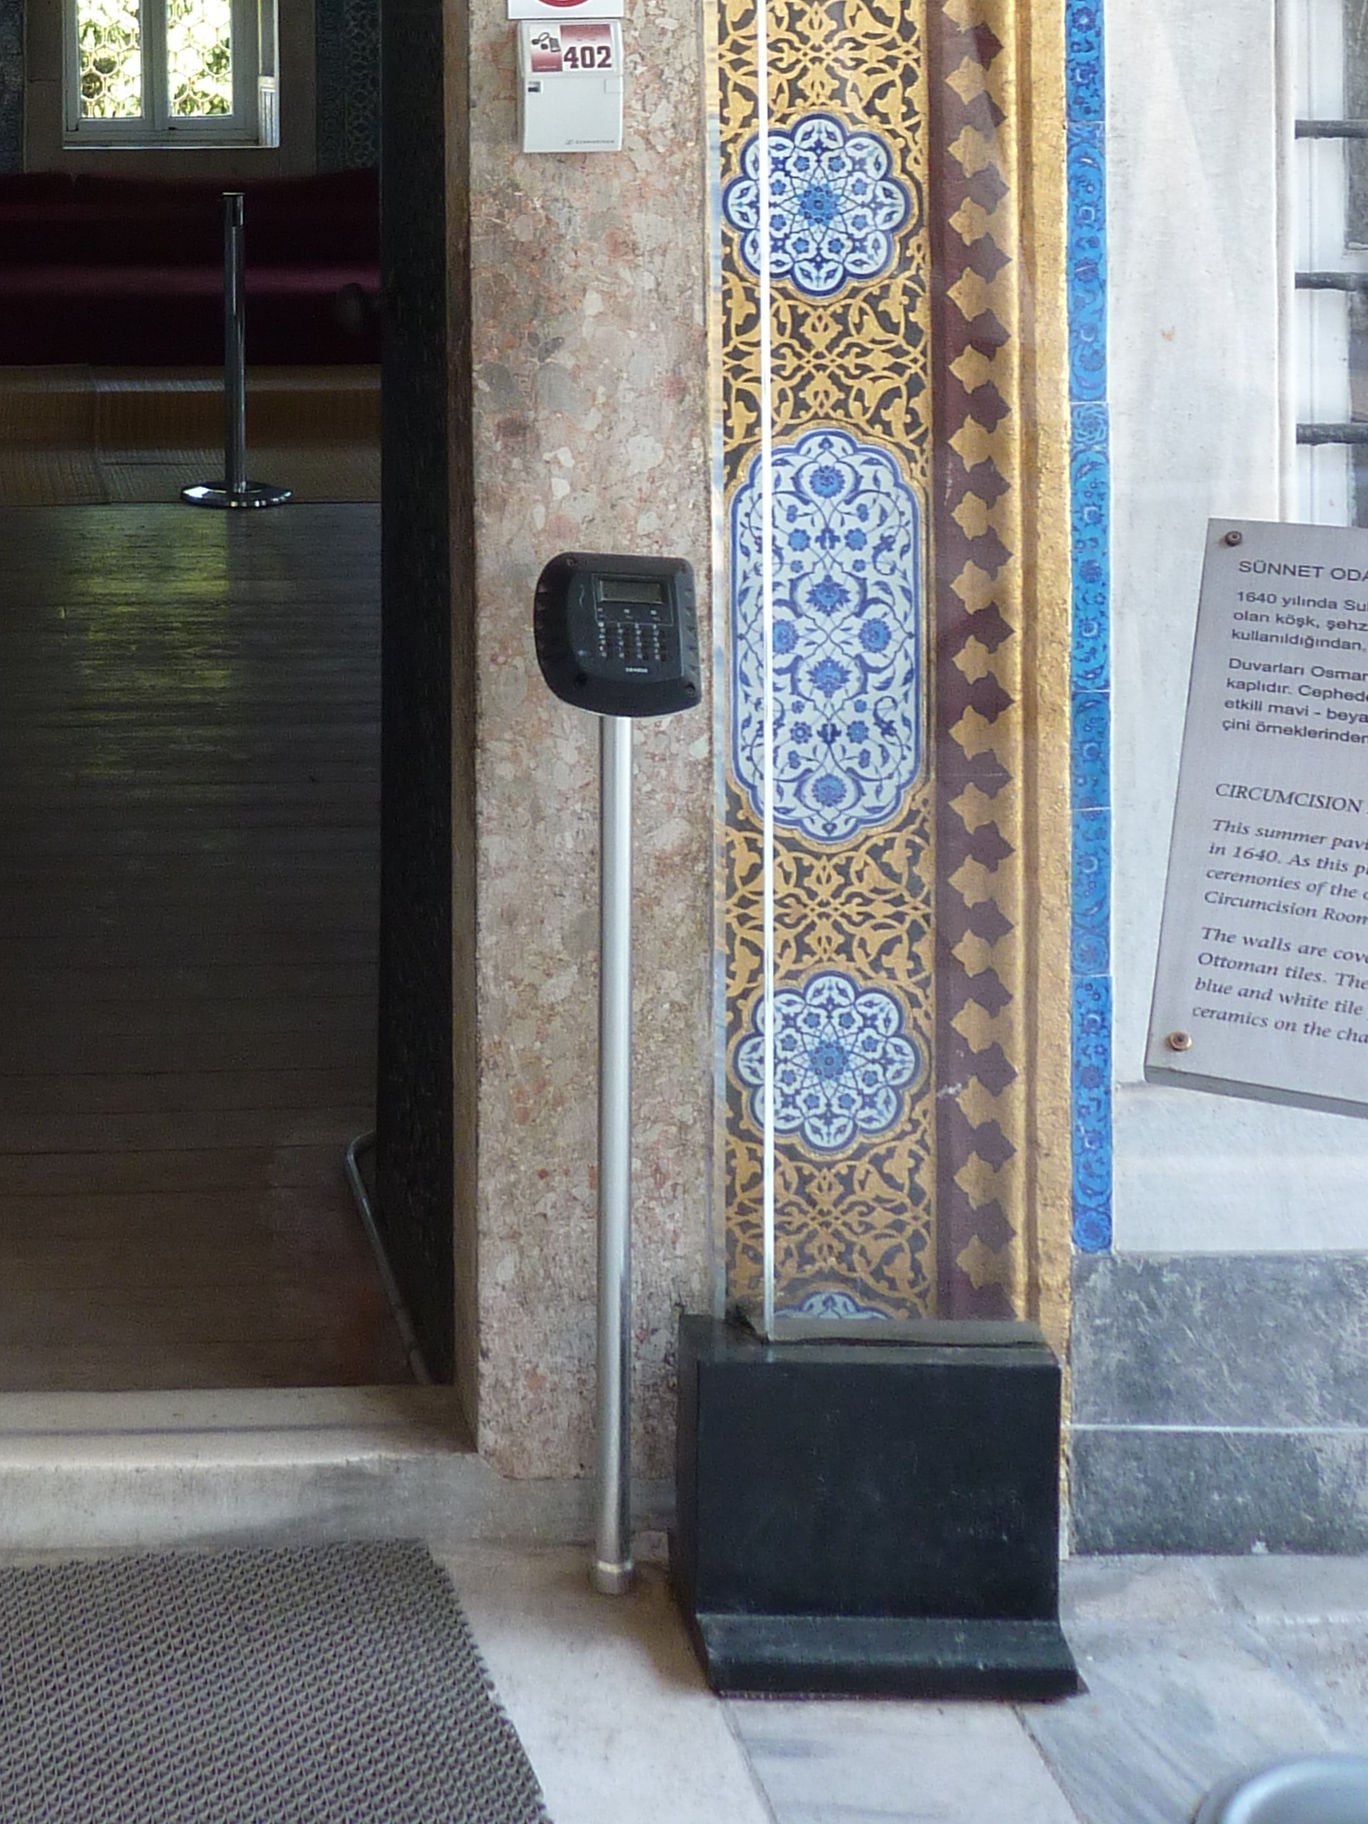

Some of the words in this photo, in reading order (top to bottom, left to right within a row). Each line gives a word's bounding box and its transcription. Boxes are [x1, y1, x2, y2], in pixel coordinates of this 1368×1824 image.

[563, 45, 612, 69] 402
[1238, 559, 1324, 578] SÜNNET
[1237, 591, 1276, 604] 1640
[1282, 595, 1338, 610] yılında
[1233, 611, 1270, 622] olan
[1276, 613, 1320, 629] köşk,
[1228, 657, 1305, 676] Duvarları
[1226, 678, 1293, 695] kaplıdır.
[1267, 704, 1309, 716] mavi
[1222, 718, 1251, 731] çini
[1215, 783, 1363, 813] CIRCUMCISION
[1212, 819, 1251, 835] This
[1255, 827, 1328, 844] summer
[1209, 843, 1226, 855] in
[1286, 854, 1311, 867] As
[1316, 857, 1349, 872] this
[1206, 869, 1301, 890] ceremonies
[1306, 881, 1328, 897] of
[1329, 884, 1358, 898] the
[1204, 891, 1317, 918] Circumcision
[1201, 926, 1237, 944] The
[1242, 935, 1292, 952] walls
[1297, 944, 1328, 957] are
[1197, 952, 1279, 976] Ottoman
[1194, 977, 1233, 995] blue
[1237, 987, 1274, 1002] and
[1278, 993, 1329, 1010] white
[1334, 1000, 1364, 1016] tile
[1192, 1006, 1269, 1028] ceramics
[1274, 1019, 1297, 1032] on
[1302, 1021, 1332, 1038] the
